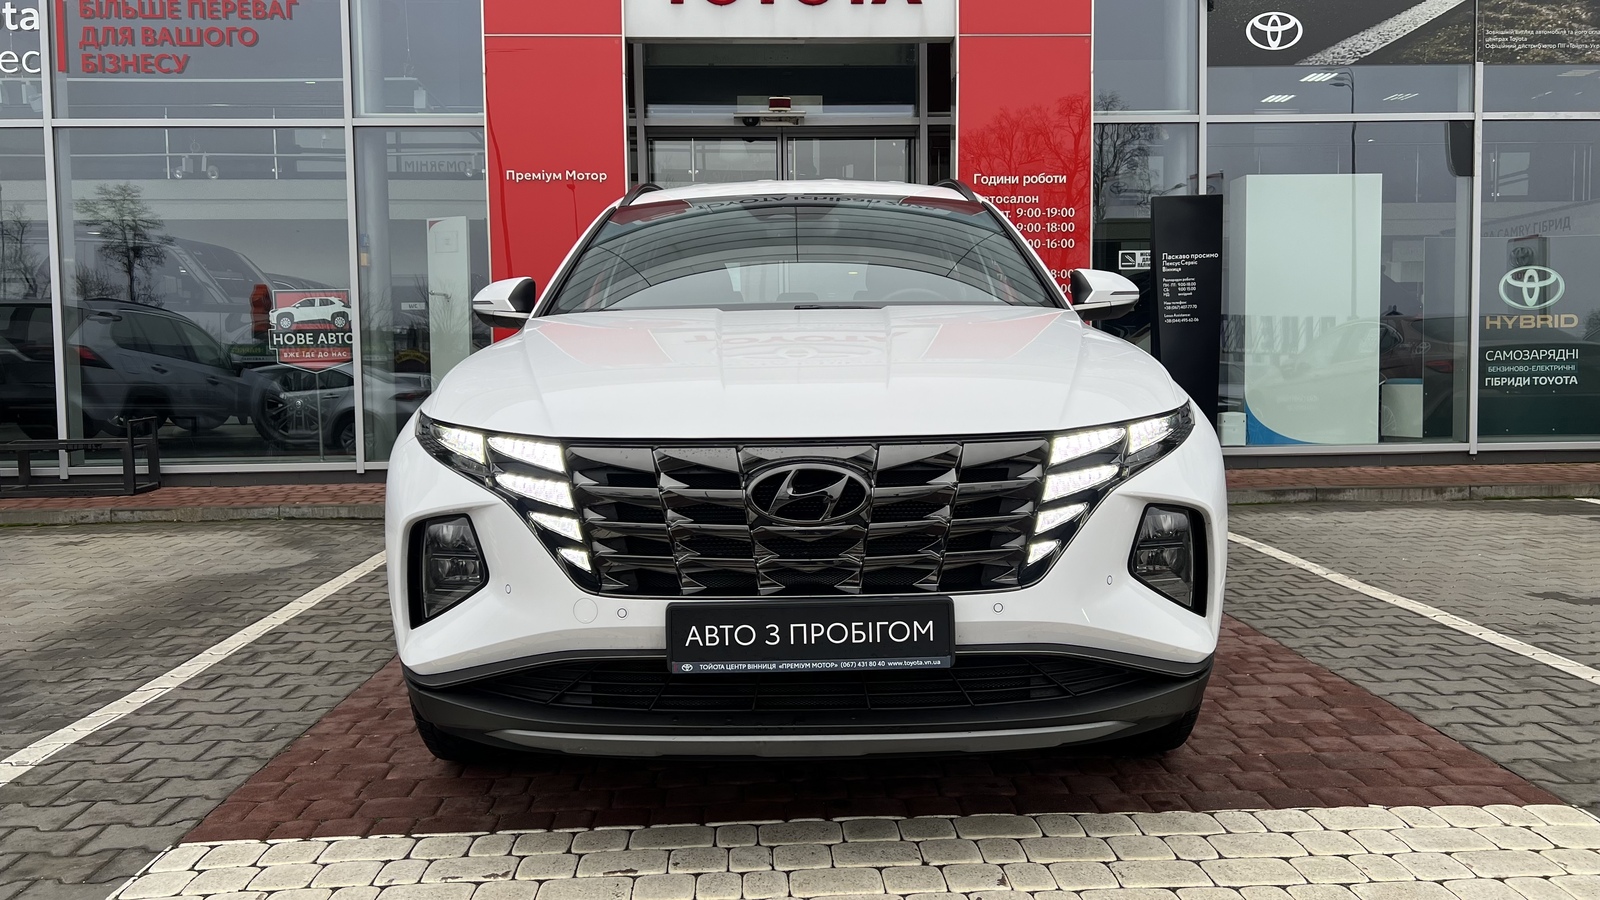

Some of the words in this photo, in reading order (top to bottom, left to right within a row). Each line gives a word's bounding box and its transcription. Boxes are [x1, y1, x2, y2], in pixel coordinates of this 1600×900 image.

[2, 2, 40, 31] ta
[79, 0, 181, 19] БІЛЬШЕ
[187, 0, 298, 19] ПЕРЕВАГ
[78, 26, 133, 49] ДЛЯ
[141, 26, 258, 47] ВАШОГО
[81, 53, 189, 74] БІЗНЕСУ
[505, 169, 563, 183] Преміум
[565, 169, 607, 183] Мотор
[973, 173, 1019, 186] Години
[1023, 173, 1067, 187] роботи
[984, 194, 1039, 204] втосалон
[1016, 207, 1075, 218] 9:00-19:00
[1016, 222, 1075, 233] 9:00-18:00
[1028, 238, 1075, 249] 00-16:00
[1162, 252, 1190, 260] Ласкаво
[1190, 252, 1219, 260] просимо
[1485, 313, 1579, 330] HYBRID
[273, 332, 314, 347] НОВЕ
[317, 332, 353, 345] АВТО
[302, 350, 316, 358] ЇДЕ
[331, 350, 348, 358] НАС
[1485, 348, 1579, 362] САМОЗАРЯДНІ
[1487, 364, 1577, 373] БЕНЗИНОВО-ЕЛЕКТРИЧНІ
[1485, 375, 1530, 388] ГІБРИДИ
[1532, 375, 1578, 387] TOYOTA
[684, 624, 757, 647] АВТО
[764, 623, 781, 646] З
[789, 620, 935, 645] ПРОБІГОМ
[699, 662, 725, 671] ТОЙОТА
[725, 663, 747, 672] ЦЕНТР
[747, 662, 777, 671] ВІННИЦЯ
[778, 662, 811, 670] «ПРЕМІУМ
[811, 661, 839, 669] МОТОР»
[840, 661, 857, 669] (067)
[887, 659, 941, 668] www.toyota.vn.ua
